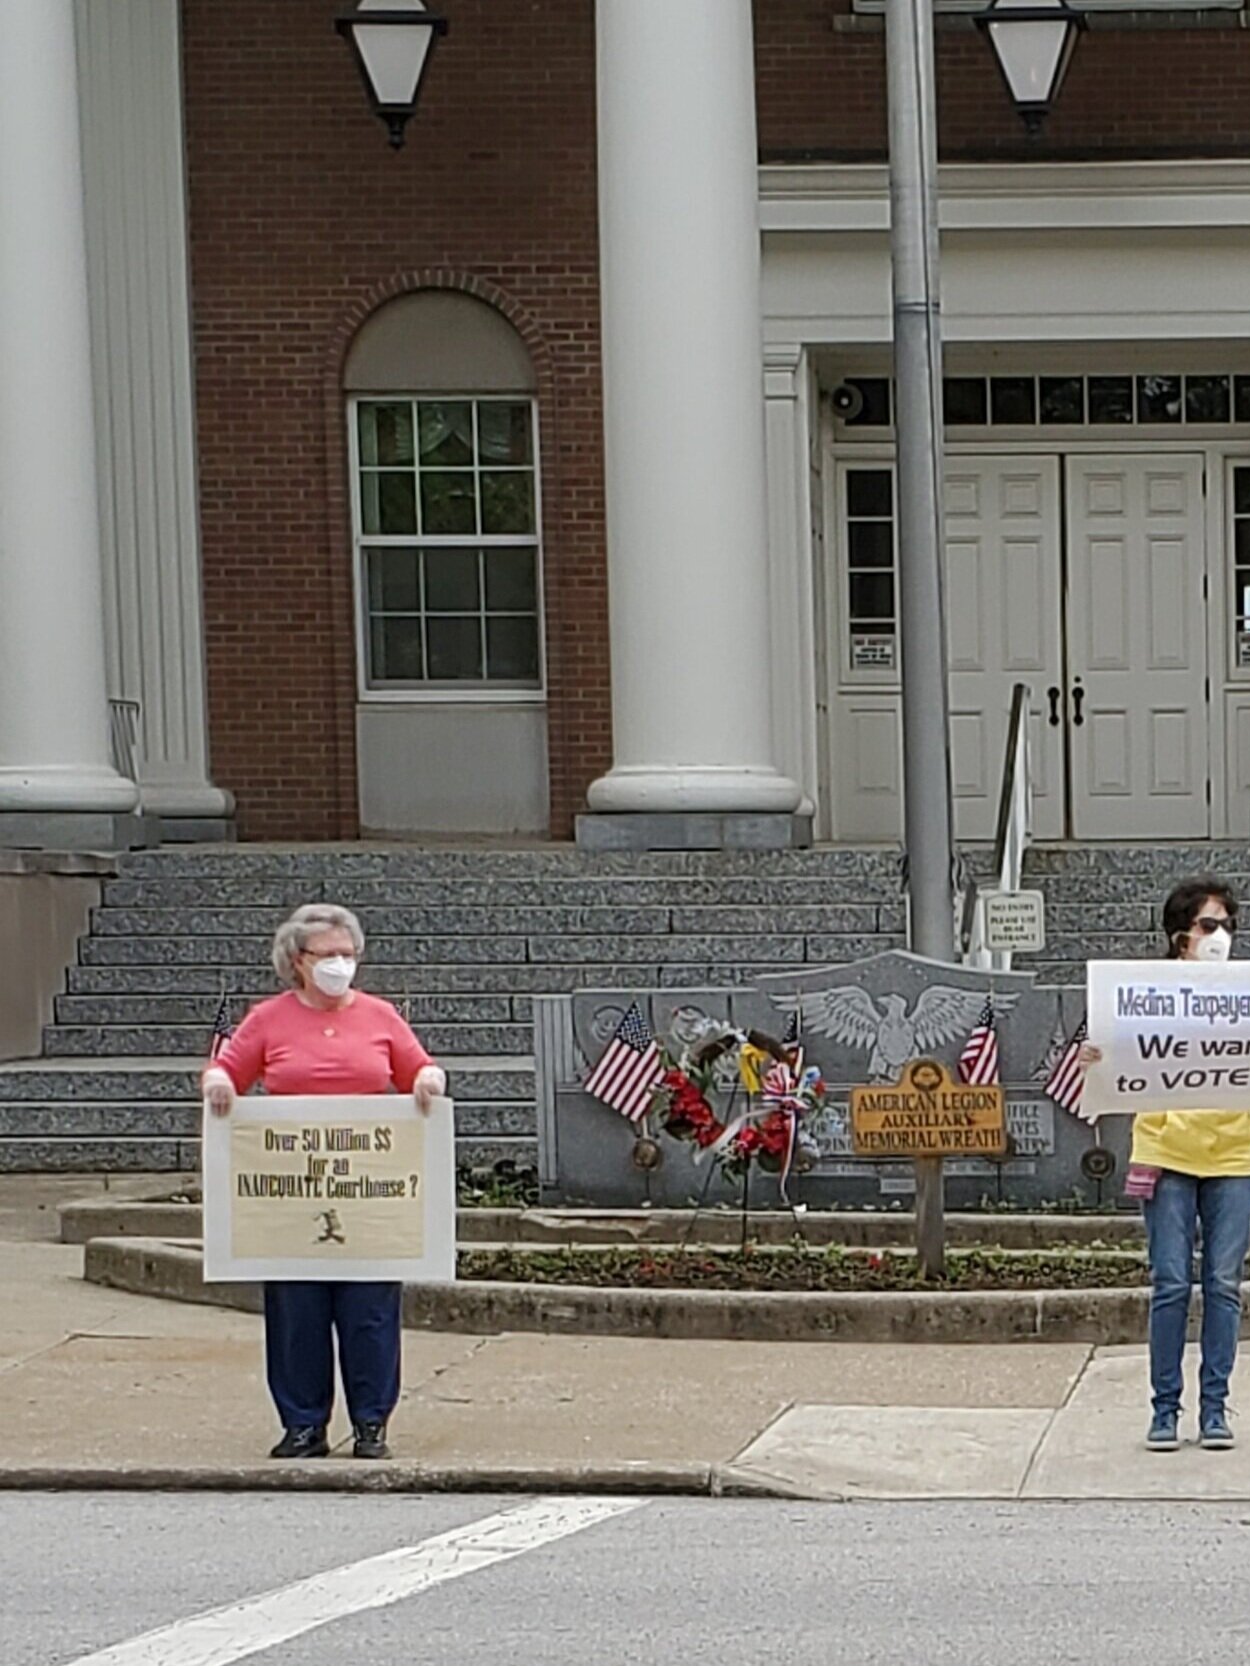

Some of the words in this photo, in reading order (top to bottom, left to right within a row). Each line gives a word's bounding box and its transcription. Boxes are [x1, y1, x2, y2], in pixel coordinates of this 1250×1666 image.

[1117, 986, 1175, 1017] Medina
[1137, 1033, 1189, 1060] We
[1117, 1074, 1147, 1092] to
[1160, 1067, 1250, 1090] VOTE
[857, 1093, 937, 1112] AMERICAN
[941, 1091, 998, 1111] LEGION
[880, 1113, 976, 1129] AUXILIARY
[265, 1128, 298, 1151] Over
[302, 1129, 320, 1151] 50
[325, 1128, 370, 1151] Million
[374, 1127, 391, 1151] $$
[856, 1130, 937, 1149] MEMORIAL
[939, 1128, 1001, 1148] WREATH
[307, 1154, 329, 1175] for
[332, 1157, 349, 1176] an
[237, 1173, 323, 1199] INADEQUATE
[326, 1174, 405, 1199] Courthouse
[409, 1174, 419, 1198] ?
